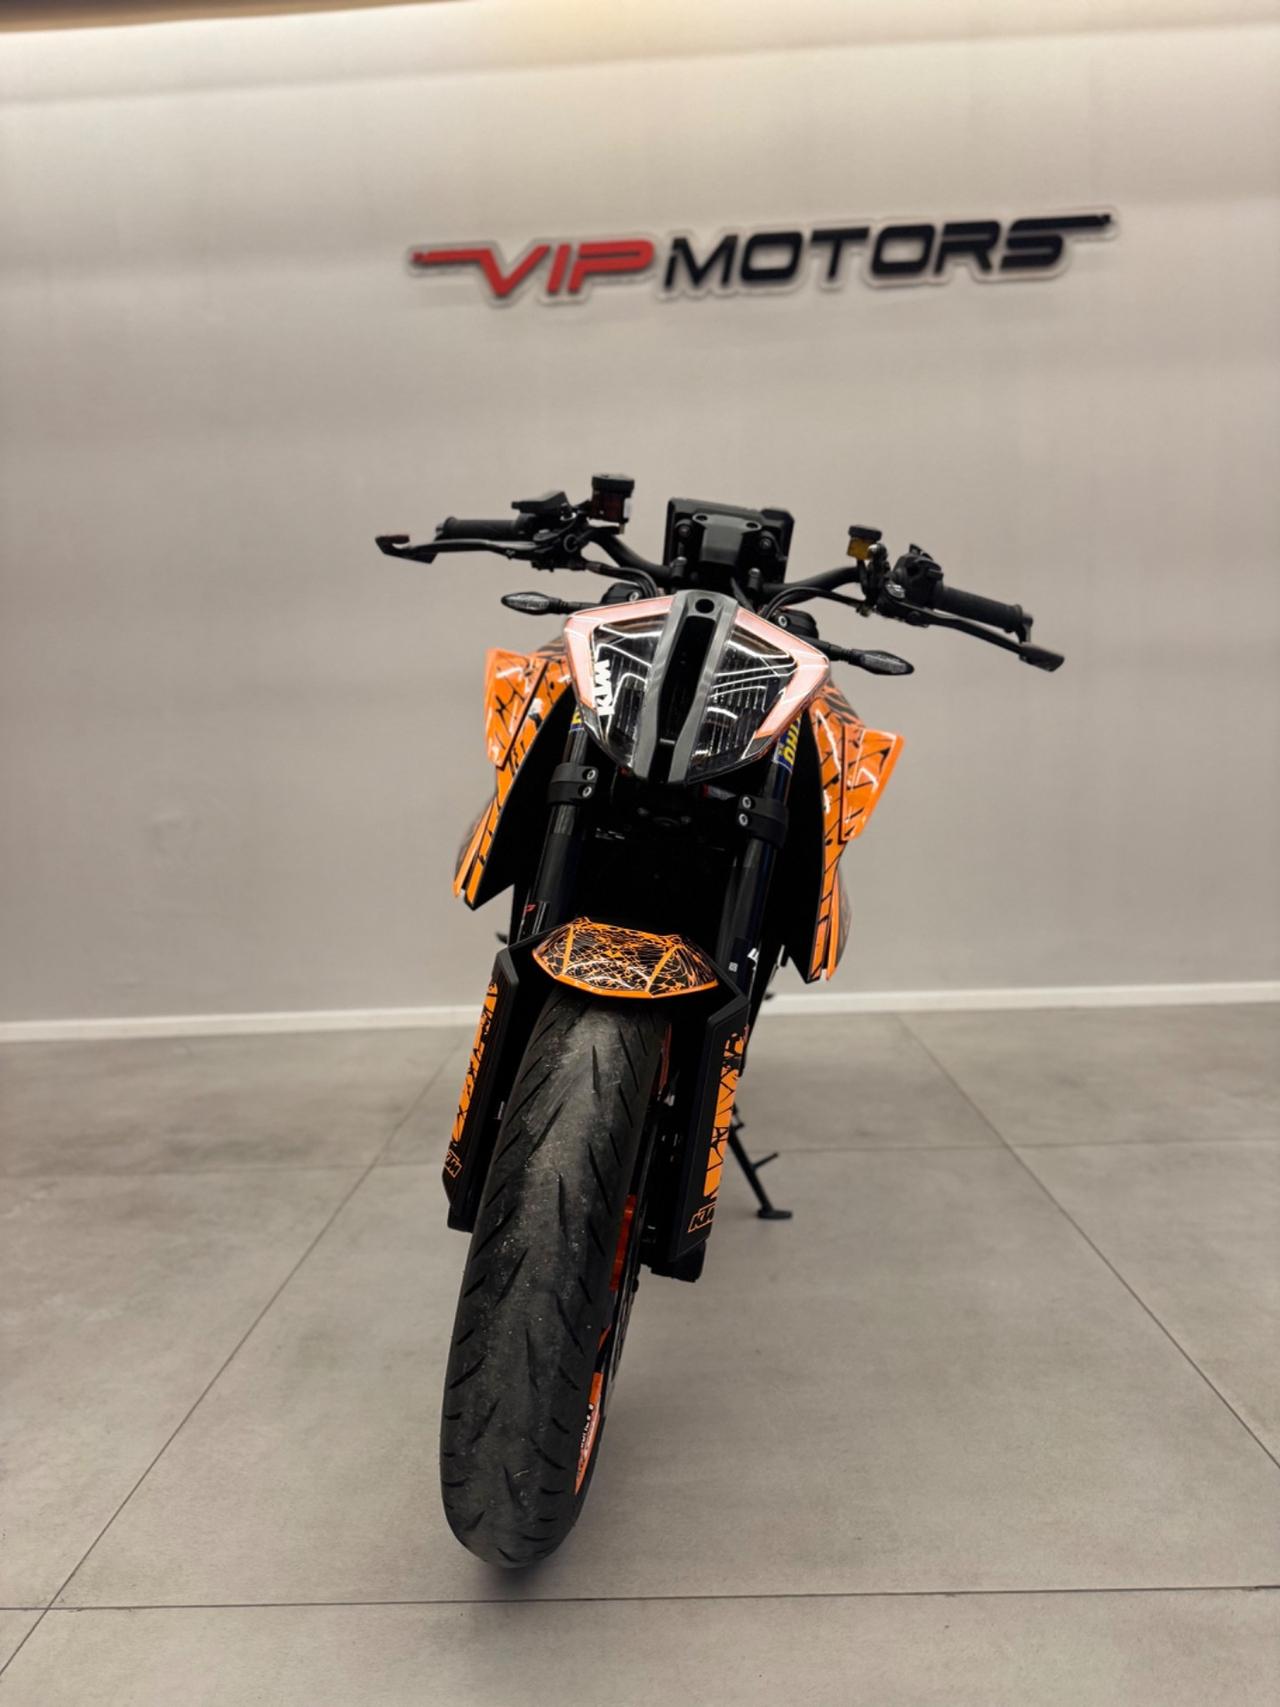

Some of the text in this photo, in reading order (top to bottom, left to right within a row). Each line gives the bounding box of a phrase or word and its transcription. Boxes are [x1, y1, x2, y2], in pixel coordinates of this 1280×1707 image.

[412, 213, 1113, 298] VIP MOTORS
[594, 659, 615, 716] KTM
